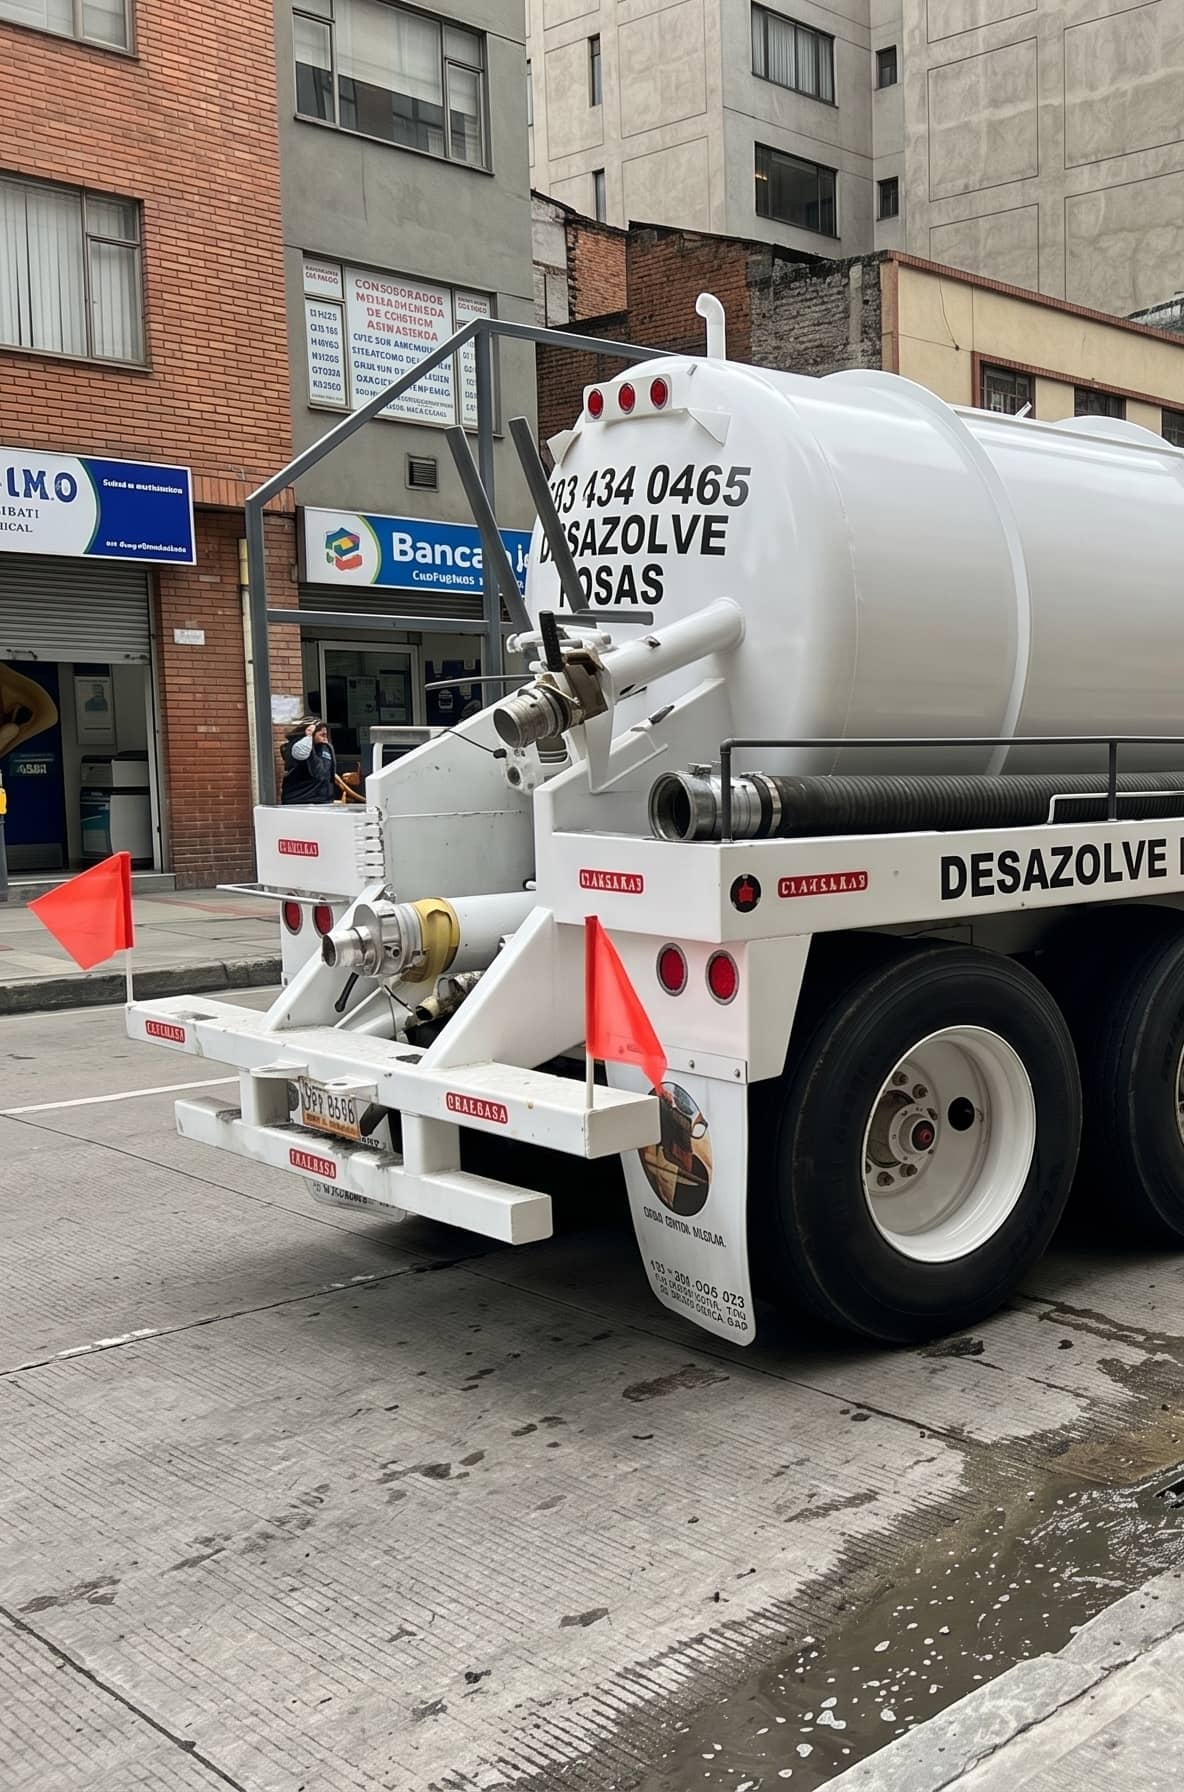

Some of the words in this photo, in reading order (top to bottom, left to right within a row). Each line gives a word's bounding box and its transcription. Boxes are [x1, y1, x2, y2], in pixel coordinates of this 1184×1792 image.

[582, 465, 637, 509] 434
[646, 464, 752, 507] 0465
[0, 505, 39, 519] IBATI
[540, 514, 729, 564] DSAZOLVE
[940, 838, 1168, 900] DESAZOLVE
